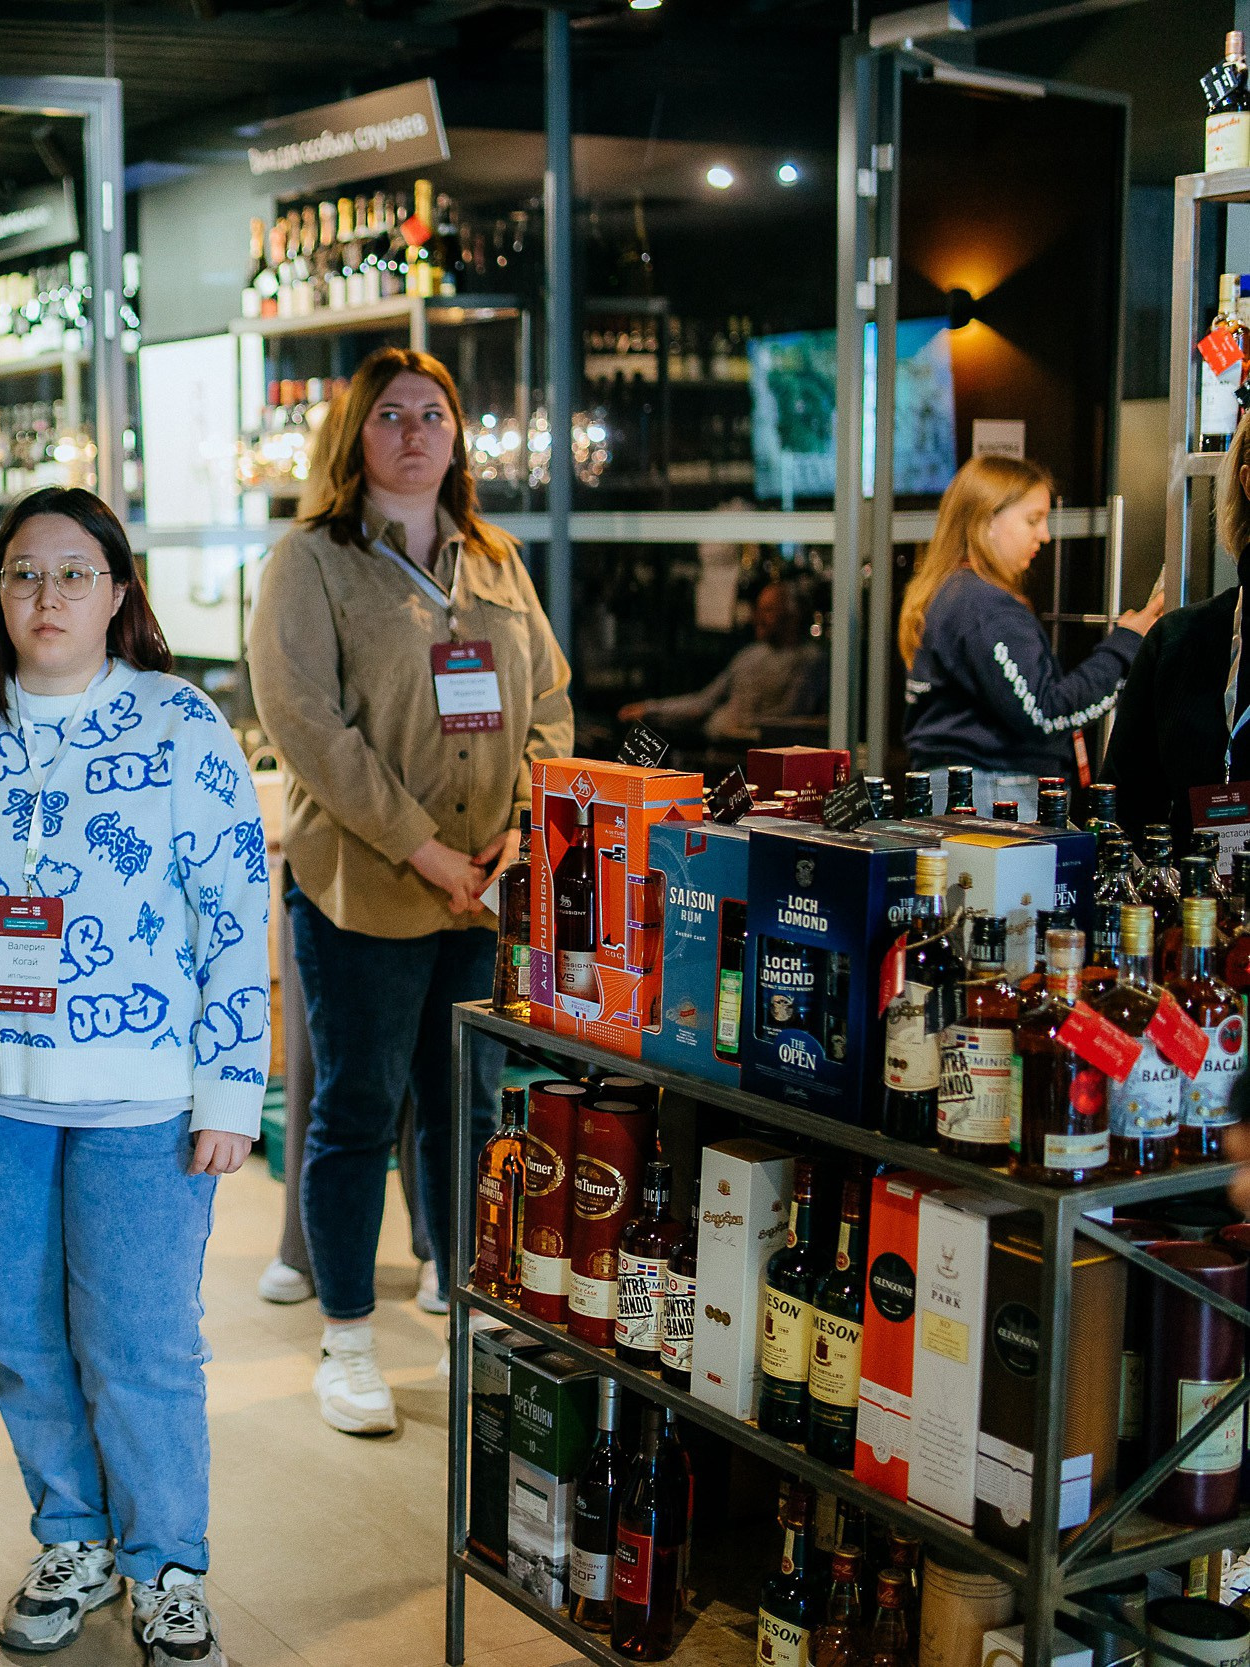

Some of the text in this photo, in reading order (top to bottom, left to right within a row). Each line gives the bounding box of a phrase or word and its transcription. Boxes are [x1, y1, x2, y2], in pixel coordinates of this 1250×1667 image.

[669, 886, 715, 912] SAISON
[788, 894, 818, 914] LOCH
[1054, 890, 1077, 906] PEN
[680, 909, 702, 924] RUM
[778, 908, 828, 932] LOMOND
[7, 941, 45, 953] Валерия
[12, 957, 38, 966] Когай
[764, 954, 801, 971] LOCH
[559, 973, 575, 983] VS
[790, 1038, 806, 1051] THE
[779, 1043, 817, 1071] OPEN
[872, 1275, 914, 1298] GLENGOYNE
[931, 1289, 961, 1309] PARK
[514, 1394, 553, 1430] SPEYBURN
